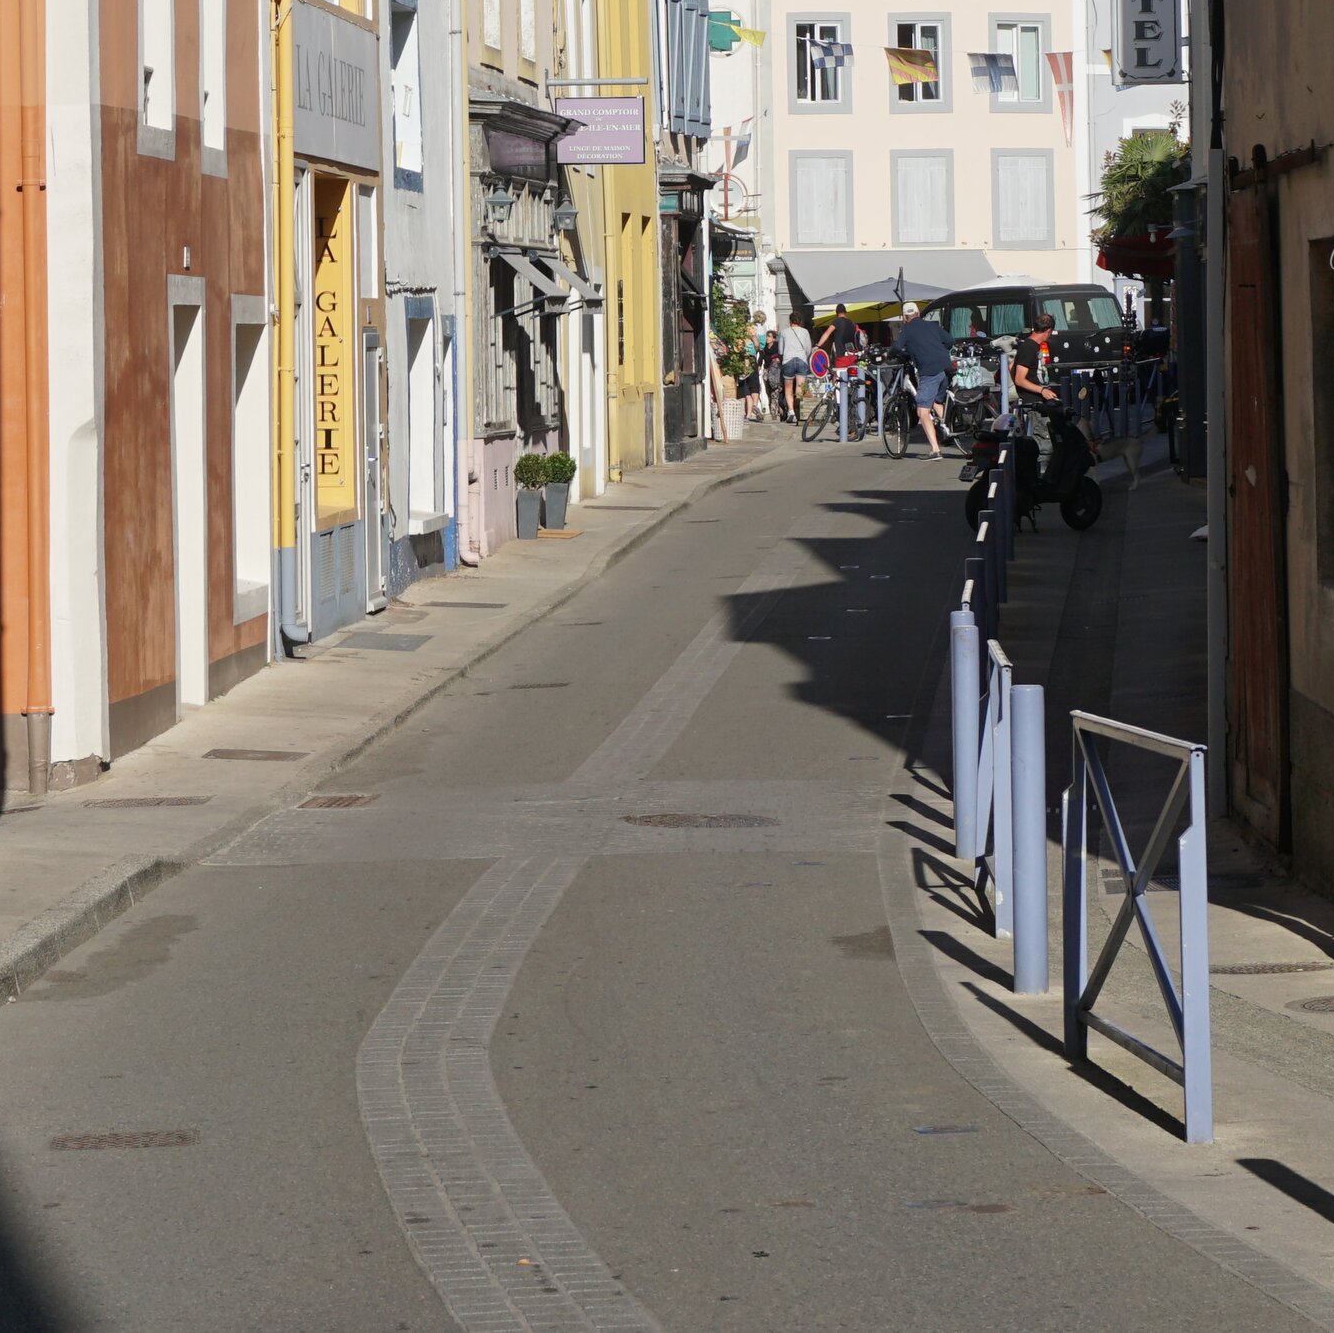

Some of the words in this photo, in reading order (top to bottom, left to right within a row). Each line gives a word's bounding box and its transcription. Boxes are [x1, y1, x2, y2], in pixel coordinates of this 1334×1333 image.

[296, 44, 313, 112] LA
[317, 50, 366, 128] GALERIE
[559, 108, 591, 116] GRAND
[592, 108, 639, 116] COMPTOIR
[315, 217, 338, 263] LA
[315, 290, 340, 475] GALERIE
